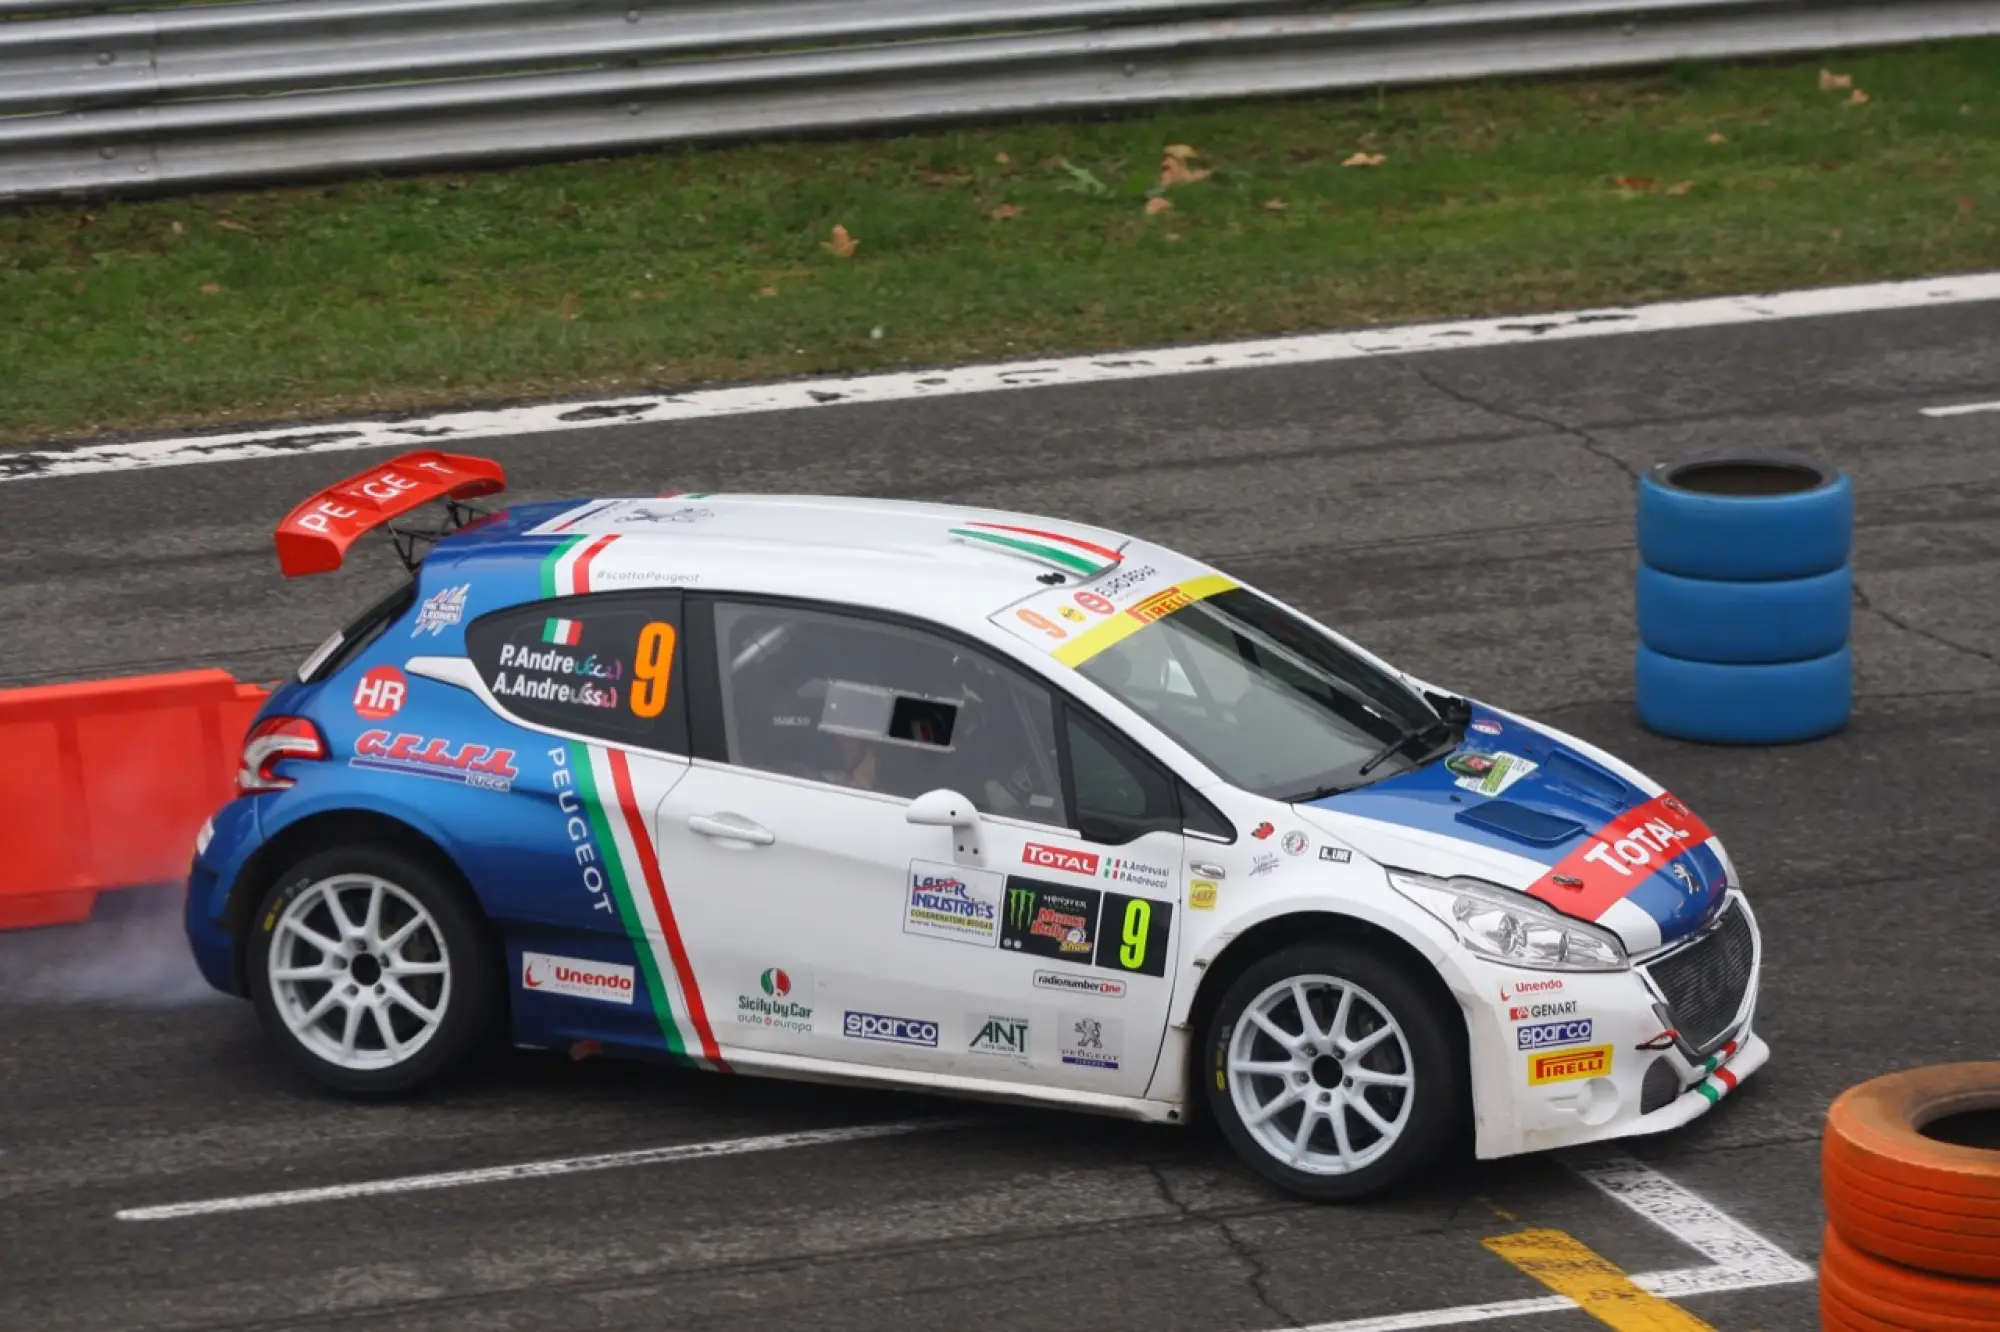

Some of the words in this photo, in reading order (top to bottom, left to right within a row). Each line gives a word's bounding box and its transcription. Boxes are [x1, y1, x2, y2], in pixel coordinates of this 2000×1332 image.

[297, 462, 453, 533] PEGET
[630, 621, 676, 719] 9
[354, 676, 406, 711] HR
[548, 748, 613, 914] PEUGEOT
[1028, 846, 1094, 871] TOTAL
[1584, 818, 1690, 876] TOTAL
[1120, 899, 1151, 969] 9
[555, 966, 631, 990] Unendo
[1515, 979, 1563, 993] Unendo
[1531, 1001, 1577, 1018] GENART
[847, 1014, 937, 1041] sparco
[969, 1021, 1028, 1052] ANT
[1519, 1021, 1591, 1048] sparco
[1536, 1051, 1605, 1079] PIRELLI
